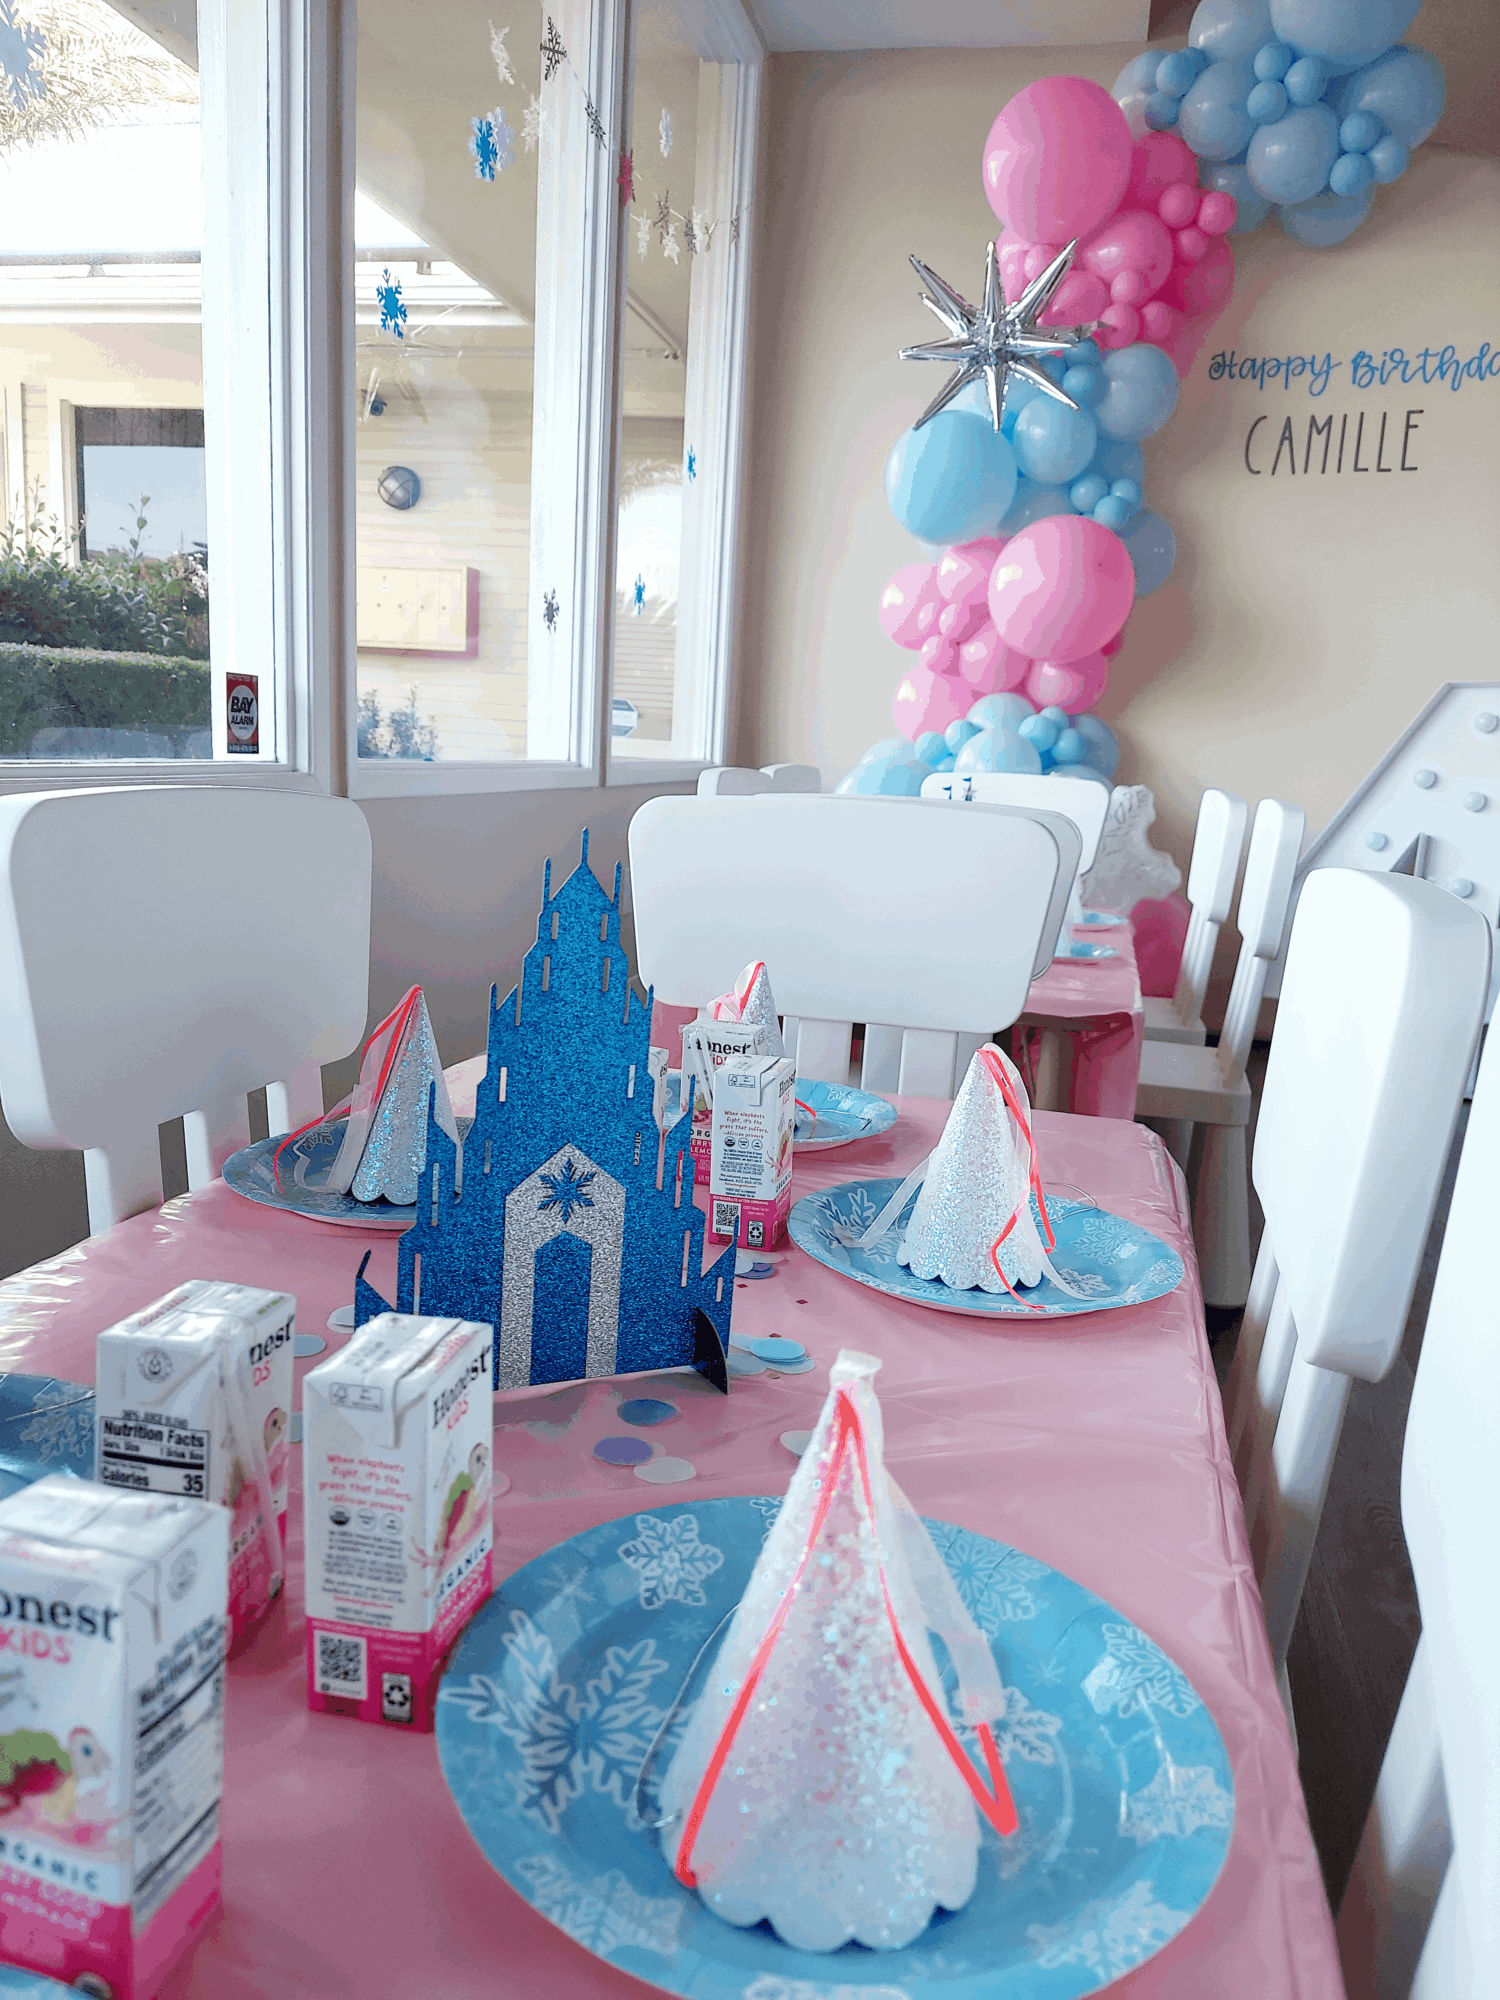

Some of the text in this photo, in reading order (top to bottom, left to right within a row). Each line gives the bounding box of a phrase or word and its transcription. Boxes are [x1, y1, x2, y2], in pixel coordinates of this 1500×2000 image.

[1209, 350, 1342, 396] Happy
[1245, 409, 1424, 475] CAMILLE
[231, 696, 254, 713] BAY
[231, 715, 254, 725] ALARM
[103, 1419, 204, 1448] Nutrition Facts
[102, 1466, 204, 1493] Calories 35
